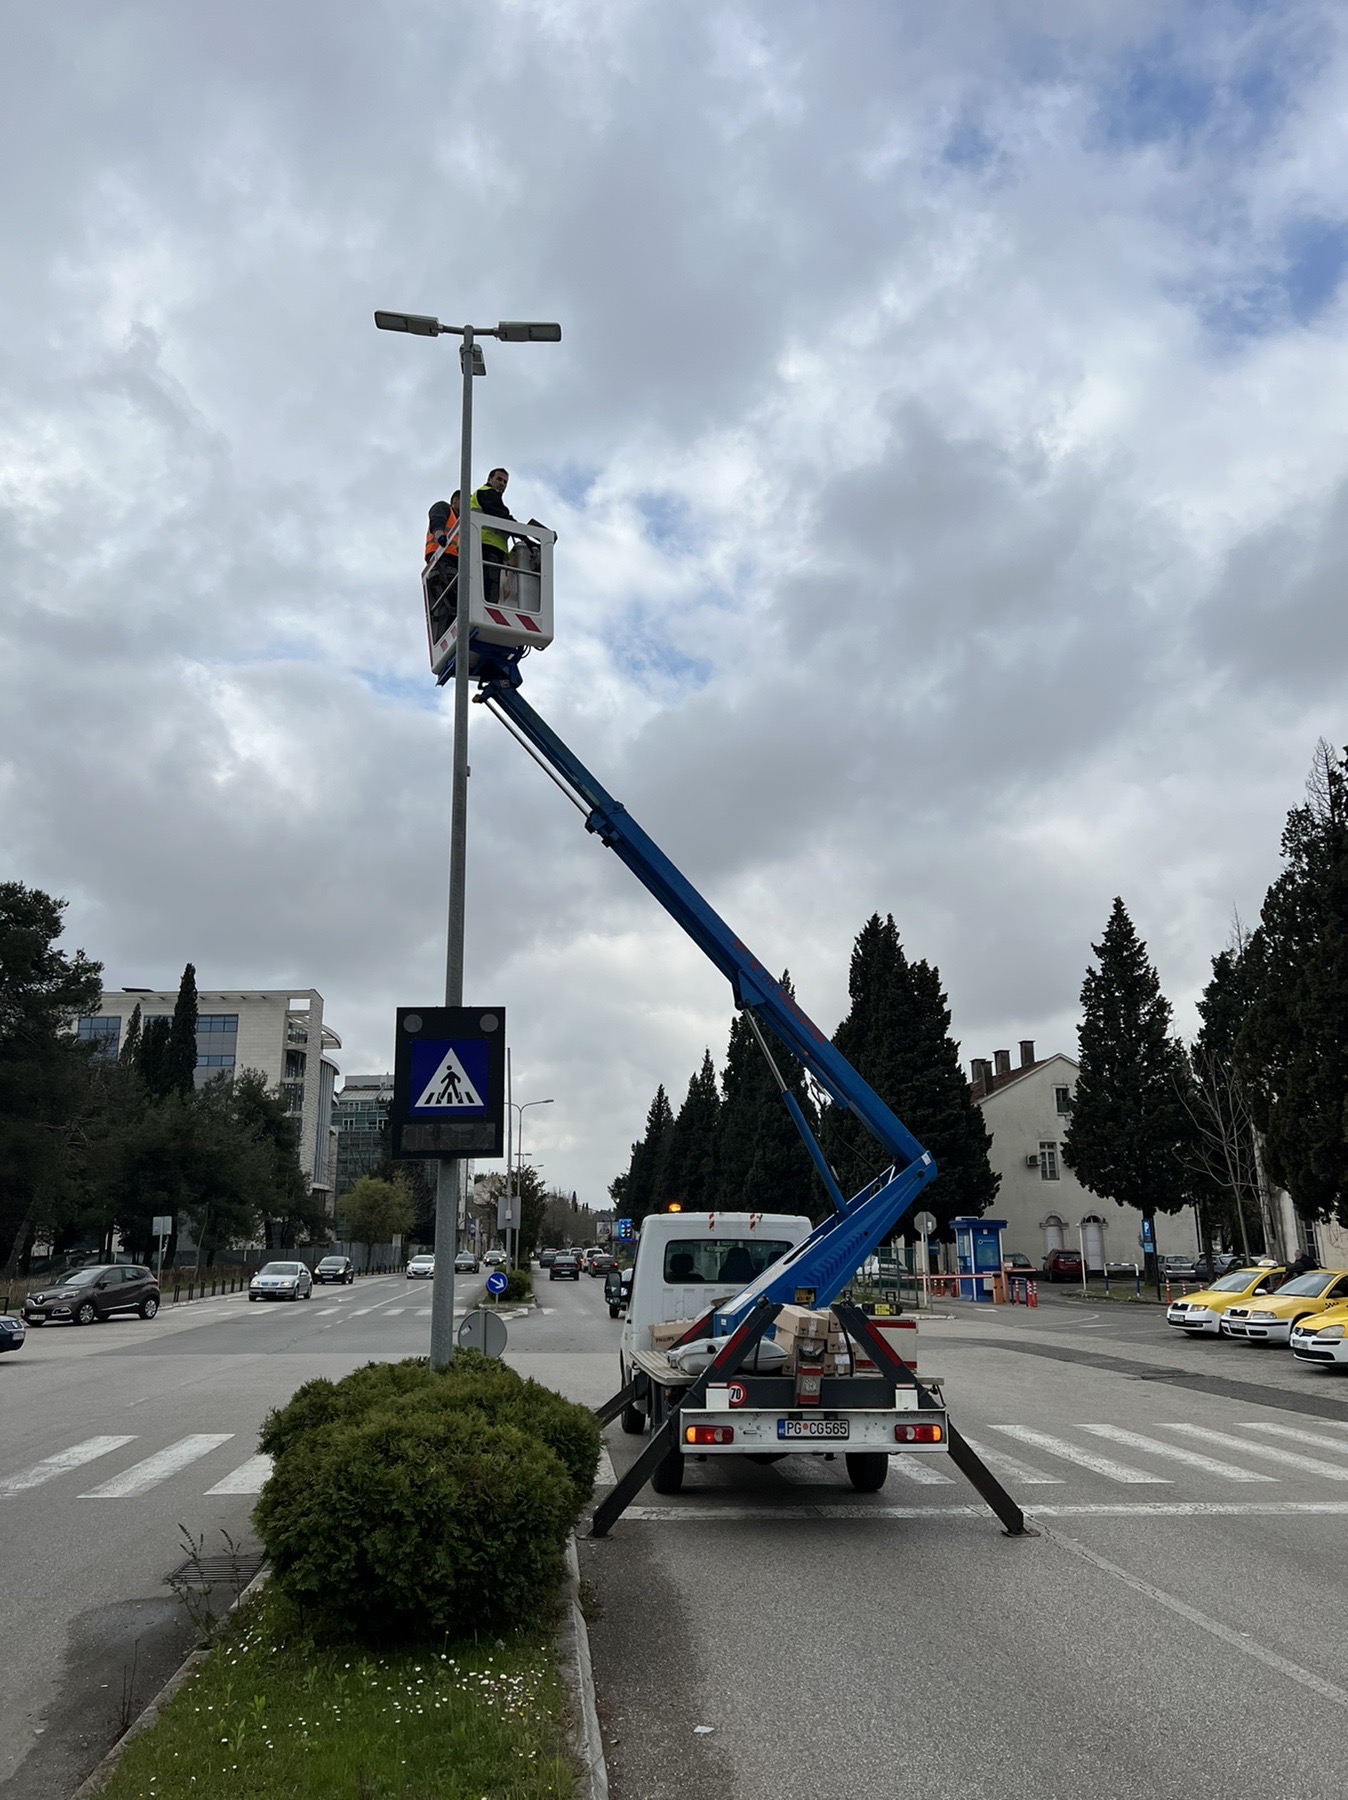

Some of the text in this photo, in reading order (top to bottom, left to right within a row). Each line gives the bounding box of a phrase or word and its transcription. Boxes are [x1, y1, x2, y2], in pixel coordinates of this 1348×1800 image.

[730, 1387, 741, 1399] 70
[787, 1422, 802, 1435] PG
[809, 1422, 847, 1435] CG565
